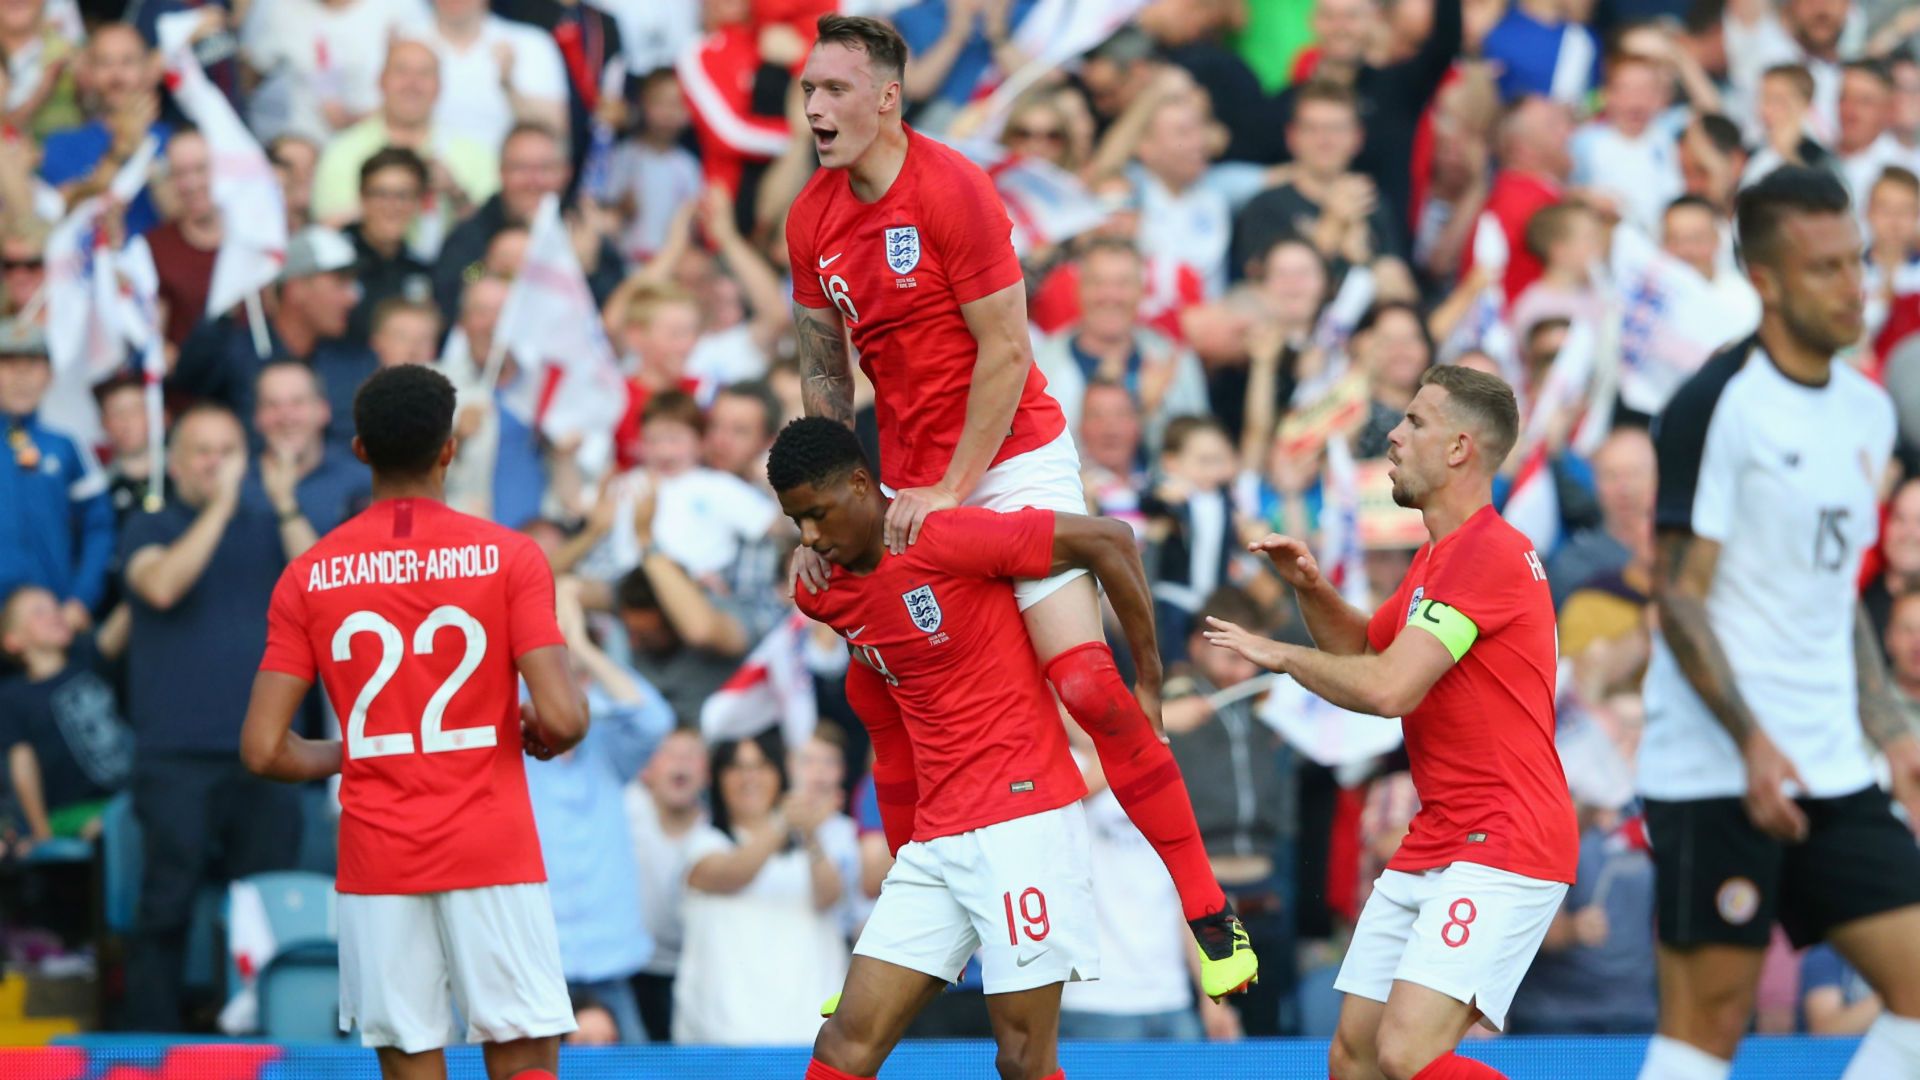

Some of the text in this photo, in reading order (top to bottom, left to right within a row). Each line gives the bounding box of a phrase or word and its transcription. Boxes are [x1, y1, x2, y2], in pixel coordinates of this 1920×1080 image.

[308, 544, 499, 592] ALEXANDER-ARNOLD
[1814, 508, 1849, 574] 15
[1423, 600, 1449, 624] C
[331, 605, 498, 760] 22
[1003, 887, 1050, 946] 19
[1441, 898, 1477, 947] 8
